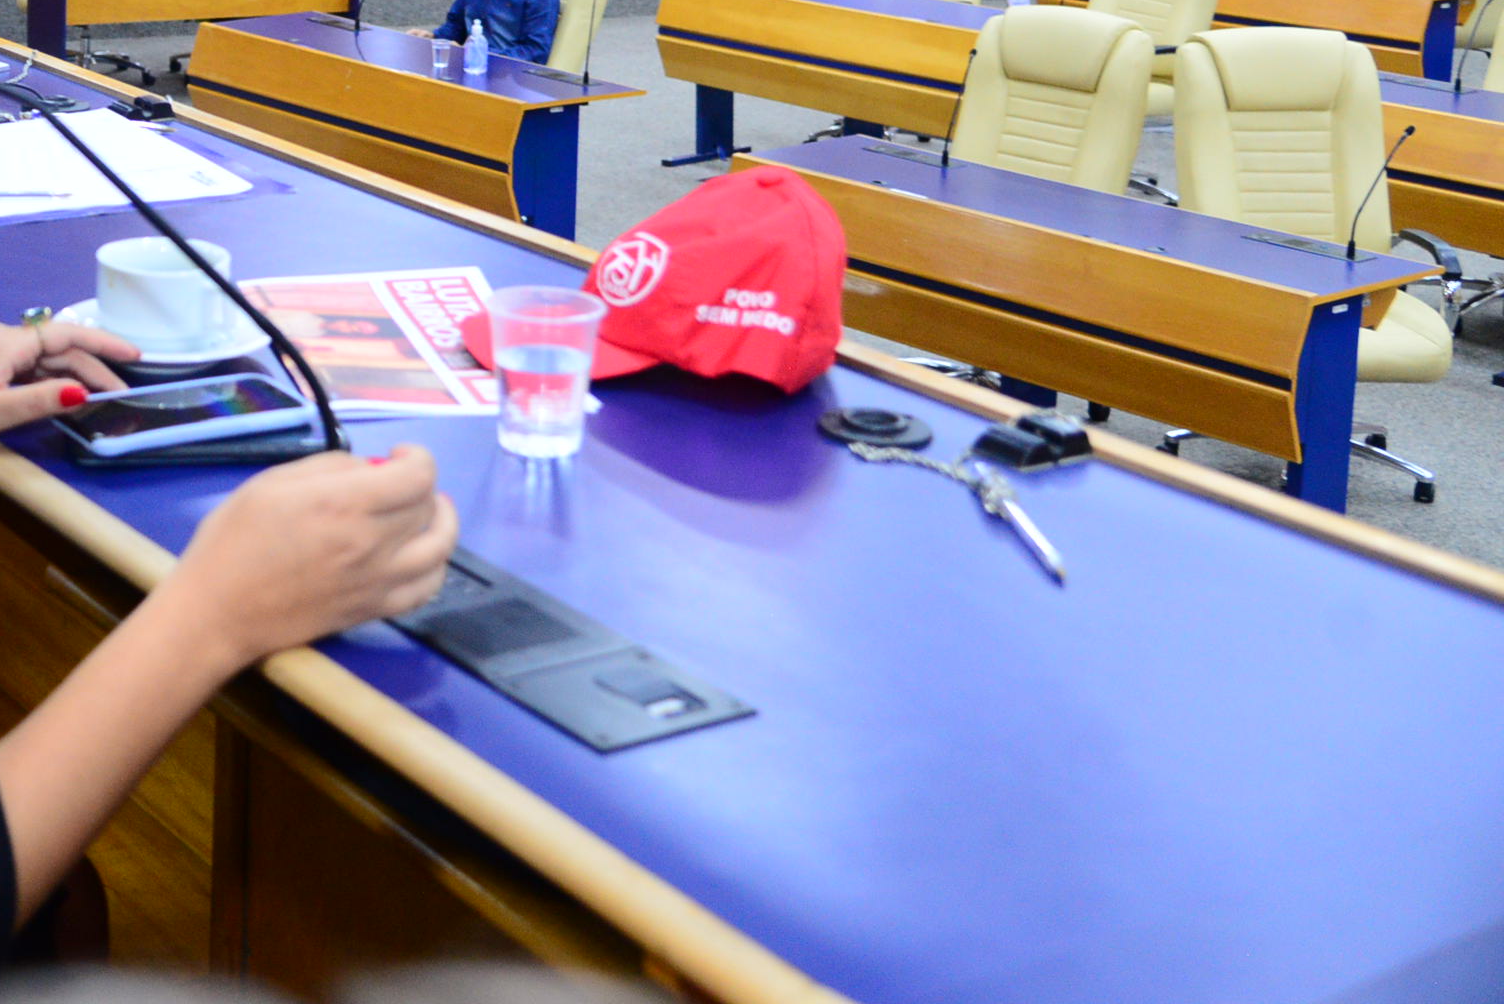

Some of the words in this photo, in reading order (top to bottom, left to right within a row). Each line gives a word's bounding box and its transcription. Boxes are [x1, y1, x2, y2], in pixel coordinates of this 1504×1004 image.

[723, 287, 775, 308] POVO
[695, 304, 739, 325] SEM
[741, 309, 795, 336] MEDO
